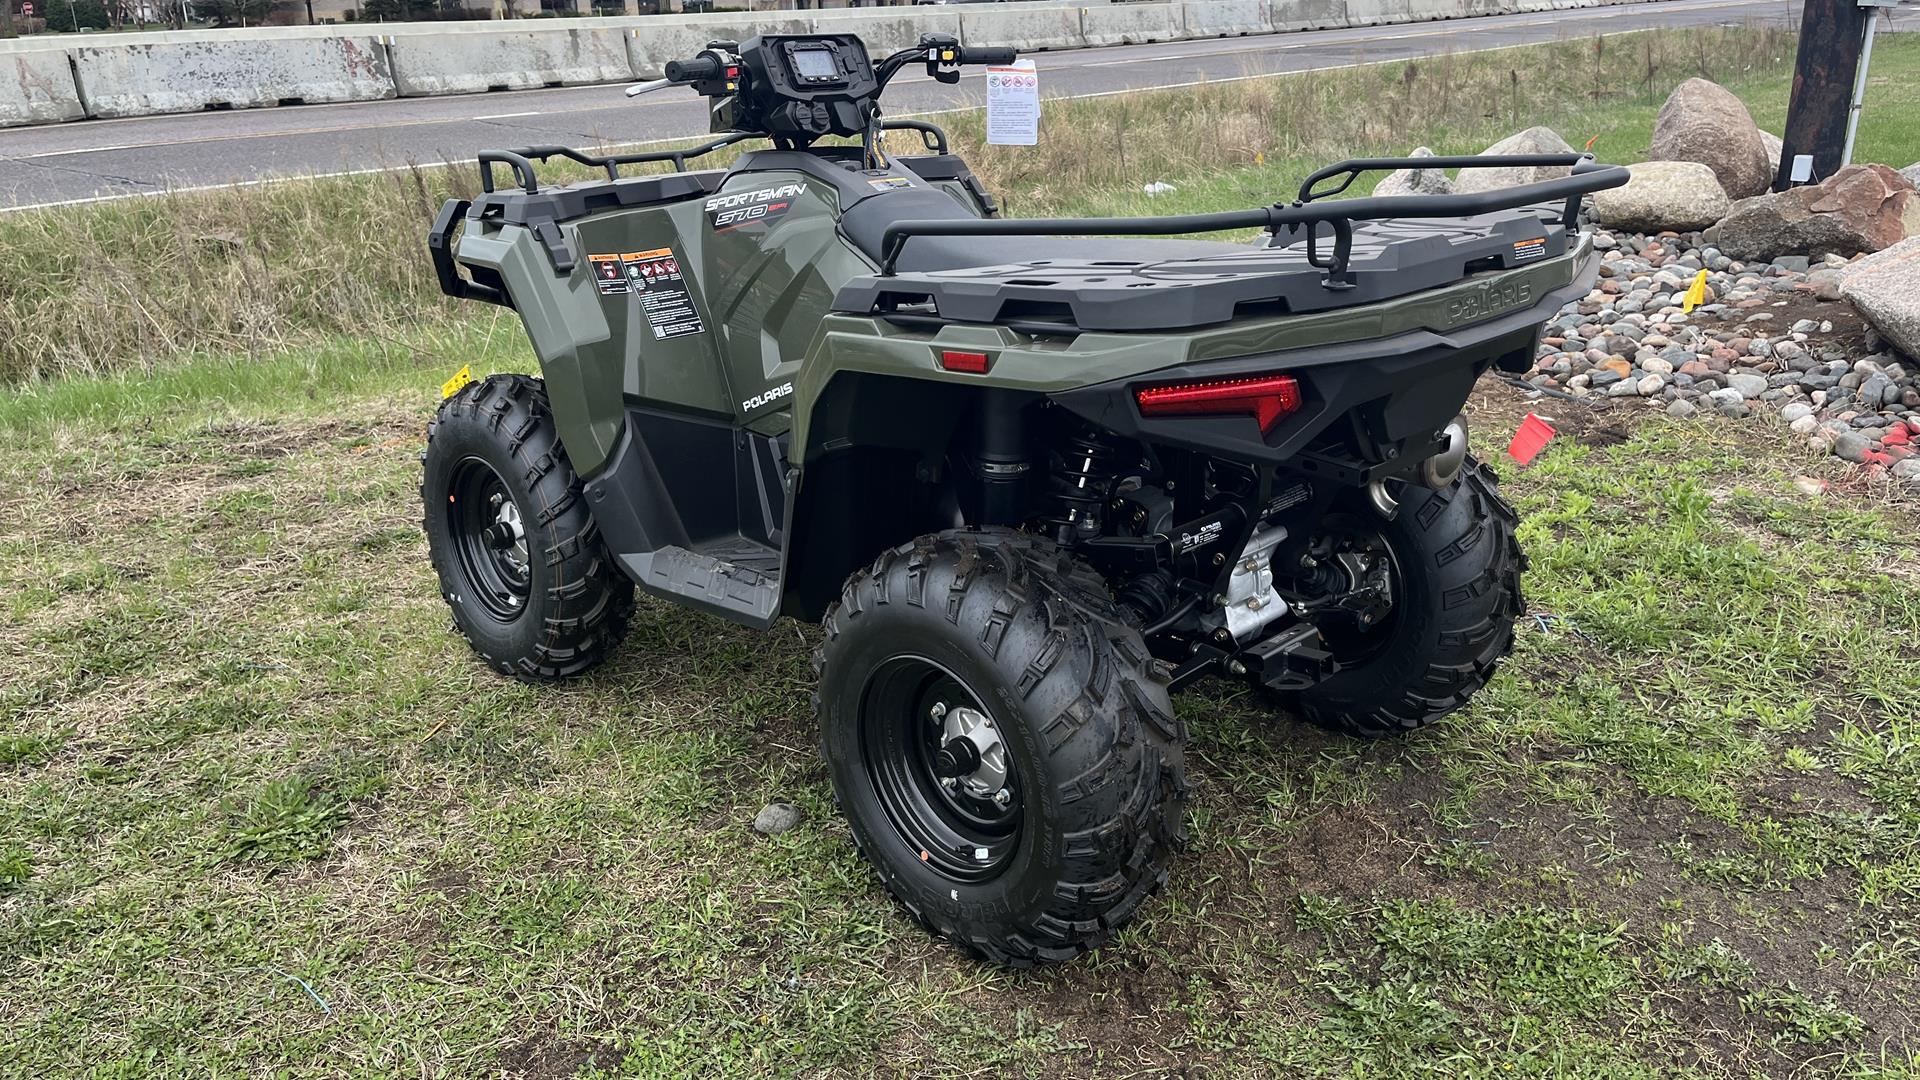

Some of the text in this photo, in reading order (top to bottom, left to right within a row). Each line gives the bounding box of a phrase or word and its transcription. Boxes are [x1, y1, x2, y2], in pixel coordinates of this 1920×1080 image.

[705, 183, 807, 212] SPORTSMAN
[715, 203, 769, 226] 570
[1446, 281, 1532, 324] POLARIS
[742, 382, 793, 412] POLARIS
